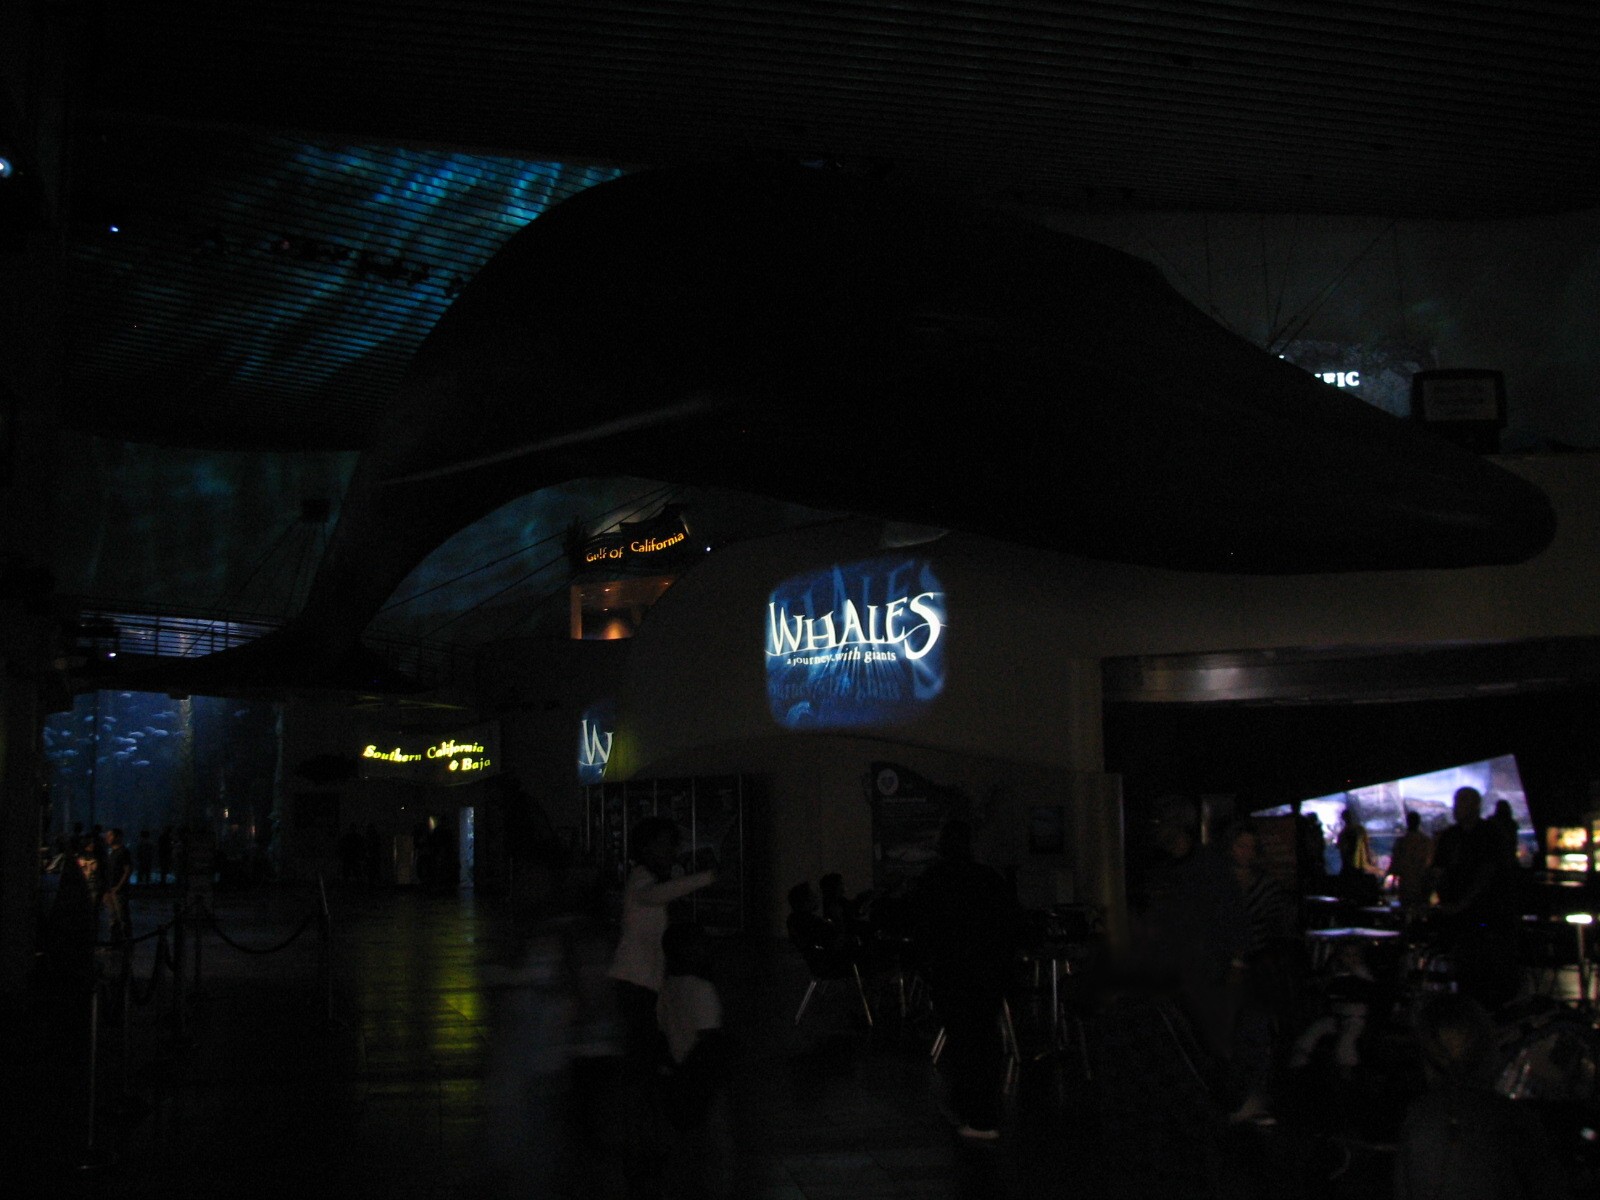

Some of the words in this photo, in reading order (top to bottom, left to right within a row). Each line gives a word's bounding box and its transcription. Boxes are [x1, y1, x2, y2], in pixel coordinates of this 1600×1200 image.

[586, 546, 607, 563] Gulf
[630, 531, 685, 553] California
[768, 591, 944, 660] WHALES
[793, 654, 832, 667] journey
[834, 646, 861, 661] with
[864, 646, 897, 664] giants
[363, 744, 422, 763] Southern
[426, 739, 485, 759] California
[461, 757, 491, 771] Baja
